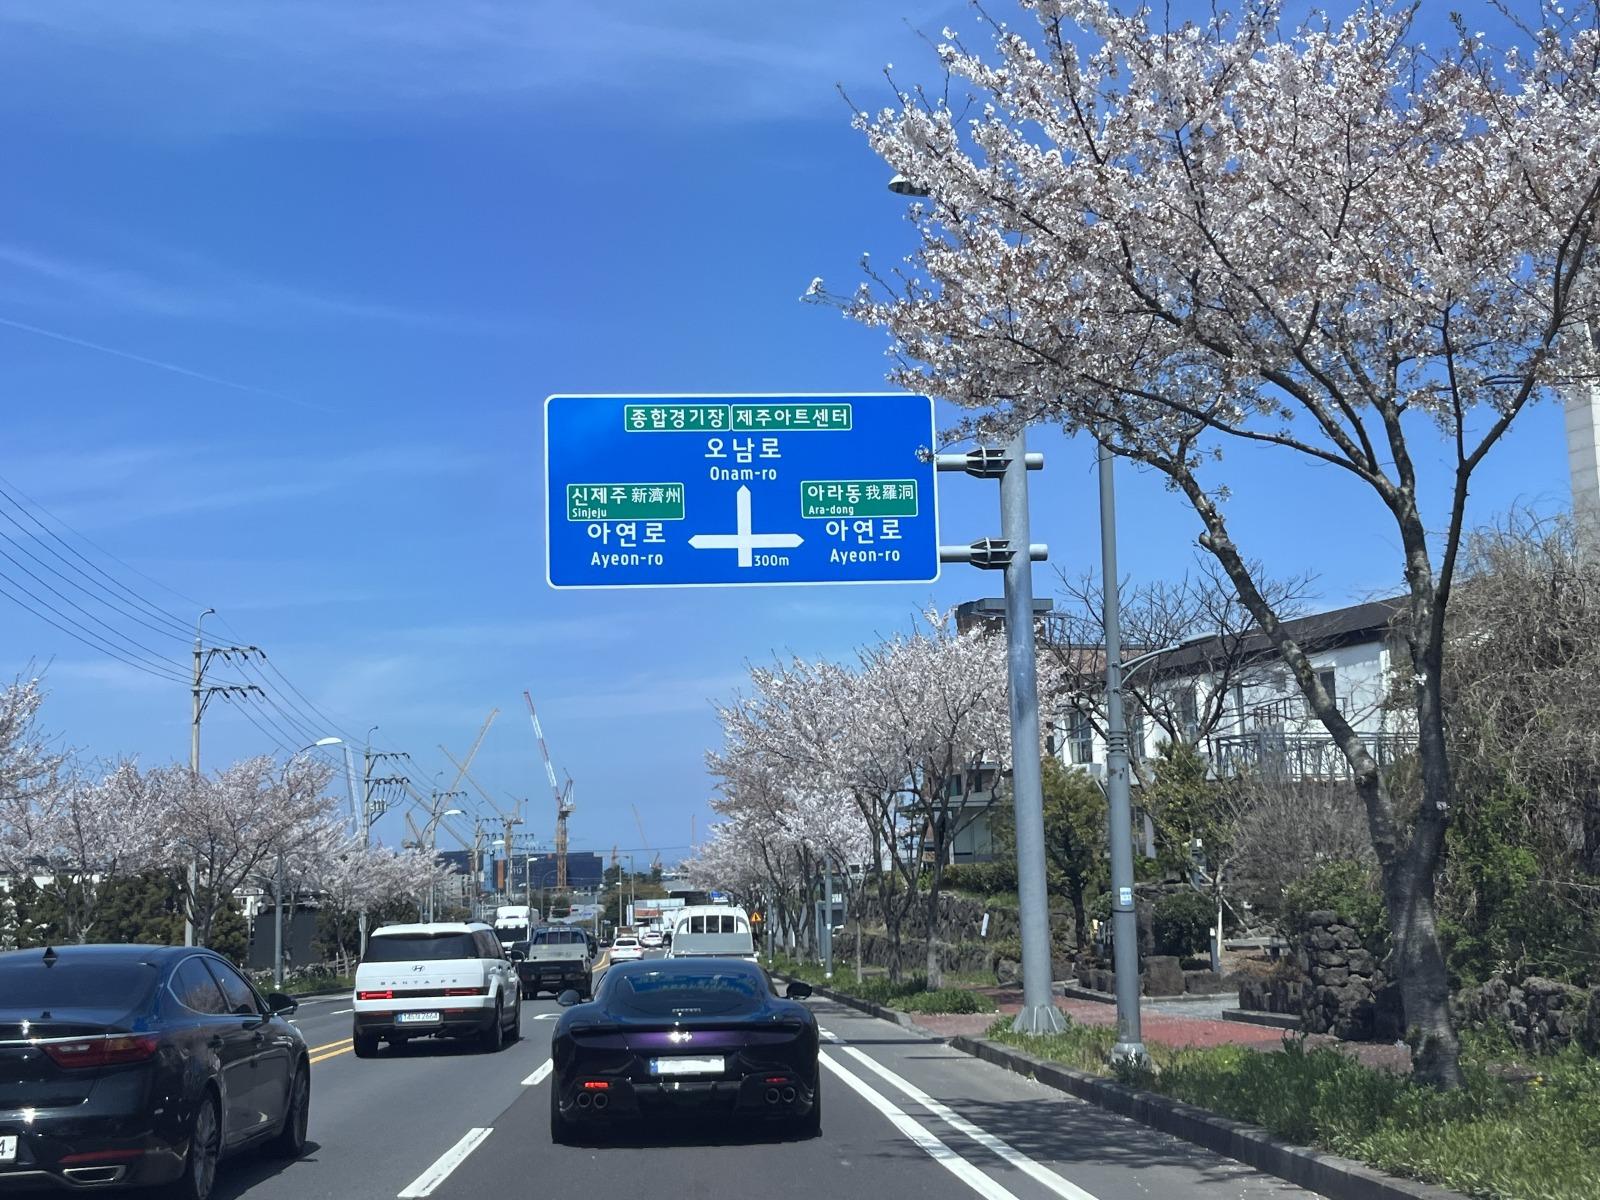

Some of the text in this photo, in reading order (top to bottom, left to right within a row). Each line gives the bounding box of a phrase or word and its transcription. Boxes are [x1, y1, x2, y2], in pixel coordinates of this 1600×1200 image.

[630, 409, 724, 428] 종합경기장
[736, 408, 848, 427] 제주아트센터
[704, 438, 782, 463] 오남로
[710, 466, 777, 481] Onam-ro
[572, 487, 681, 506] 신제주 新濟州
[807, 484, 914, 504] 아라동 我羅洞
[572, 508, 607, 519] Sinjeju
[808, 505, 854, 516] Ara-dong
[587, 522, 666, 547] 아연로
[825, 519, 903, 544] 아연로
[590, 551, 664, 568] Ayeon-ro
[754, 555, 790, 567] 300m
[830, 548, 901, 565] Ayeon-ro
